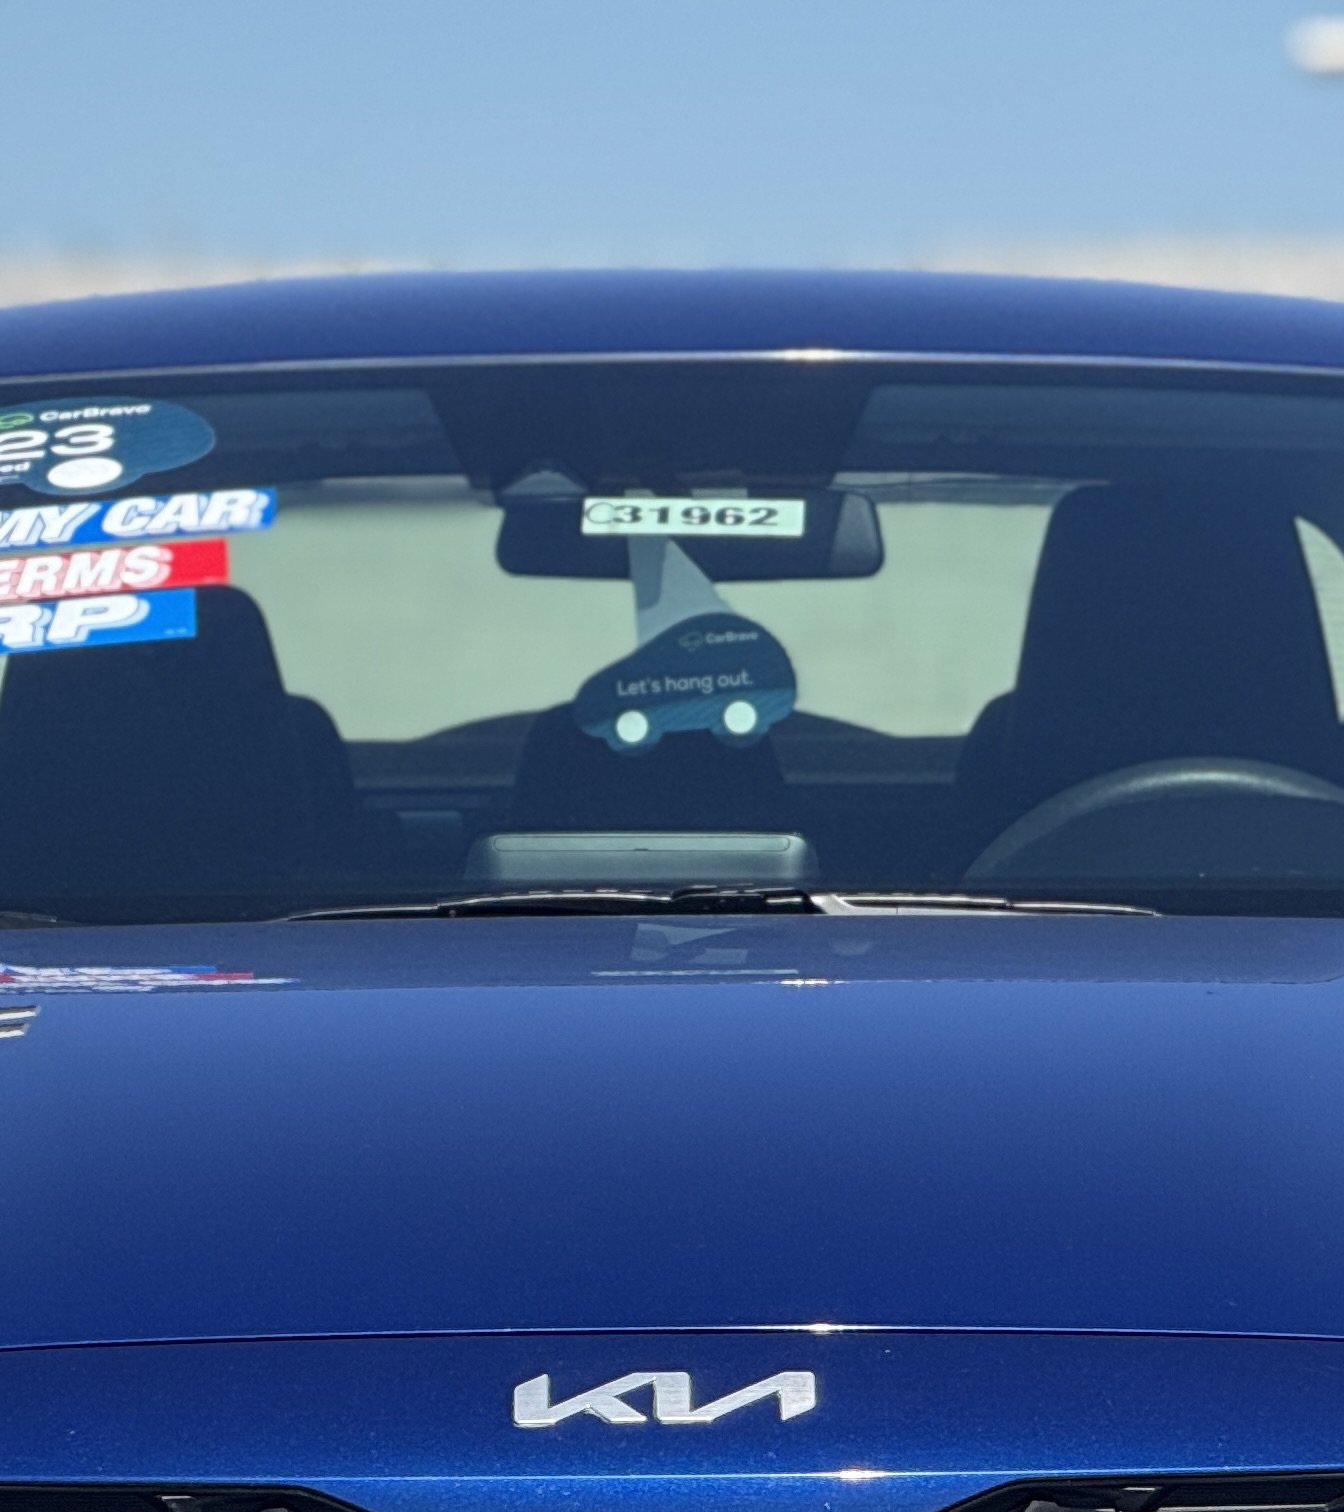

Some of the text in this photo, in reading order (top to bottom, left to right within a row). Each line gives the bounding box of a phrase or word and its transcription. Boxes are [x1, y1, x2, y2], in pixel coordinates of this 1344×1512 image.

[102, 489, 270, 538] CAR
[617, 669, 754, 697] Let's hang out.
